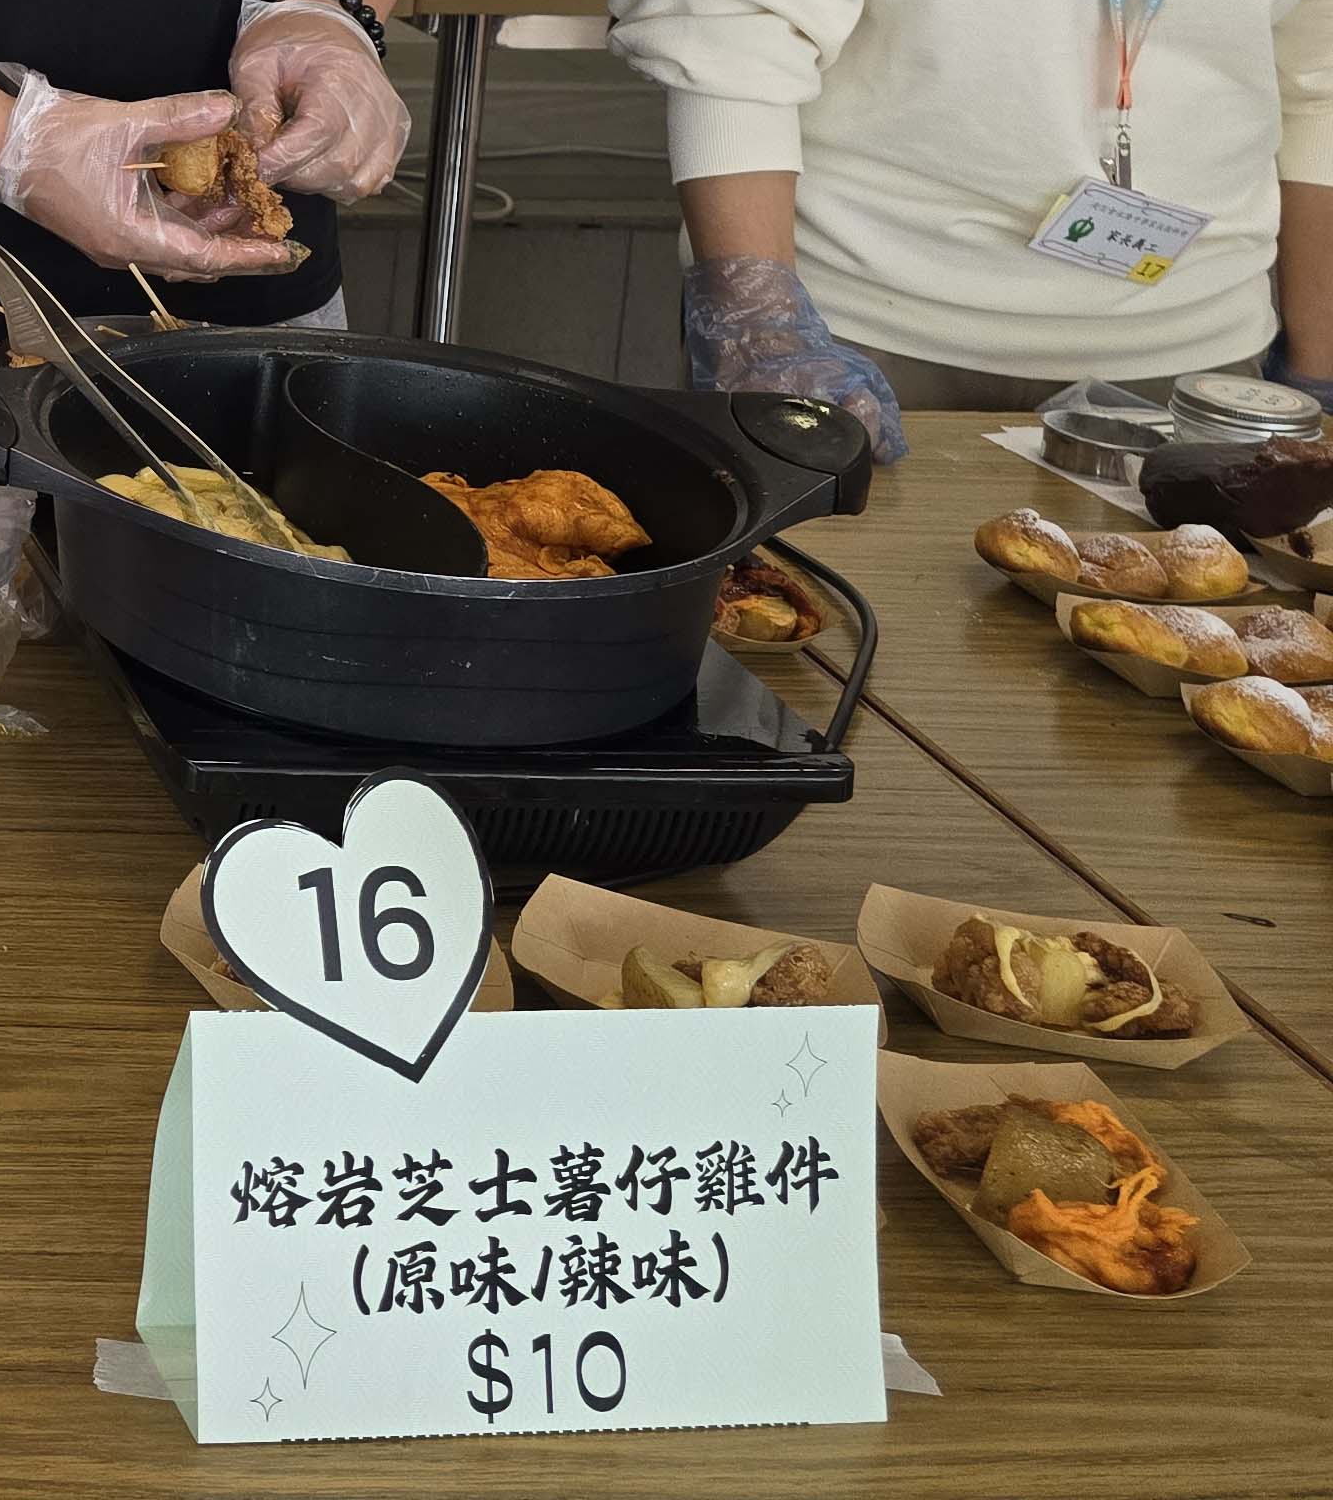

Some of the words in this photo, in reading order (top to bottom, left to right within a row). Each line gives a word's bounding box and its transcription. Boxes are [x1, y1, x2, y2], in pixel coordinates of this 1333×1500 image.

[1135, 261, 1167, 279] 17
[296, 864, 436, 983] 16
[230, 1135, 841, 1229] 熔岩芝士薯仔雞件
[351, 1231, 731, 1317] (原味/辣味)
[466, 1327, 629, 1424] $10
